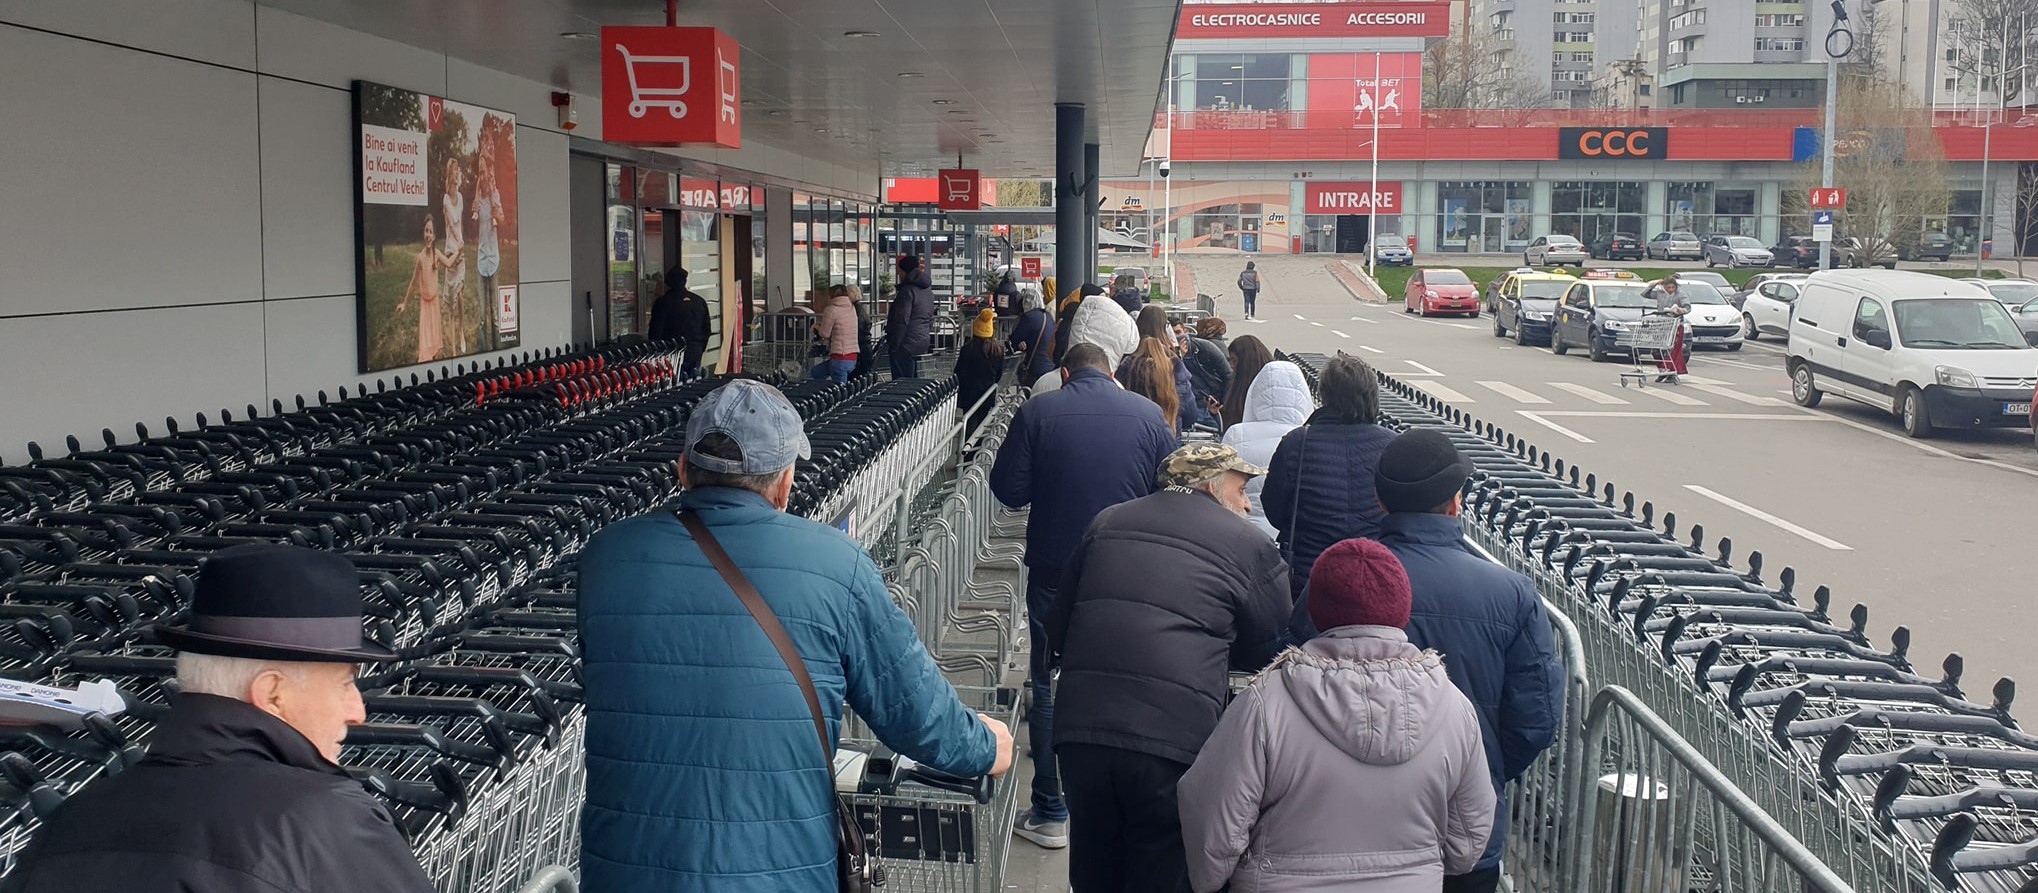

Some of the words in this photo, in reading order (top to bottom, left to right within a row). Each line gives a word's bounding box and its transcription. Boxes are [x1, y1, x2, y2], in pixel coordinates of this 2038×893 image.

[1192, 14, 1320, 26] ELECTROCASNICE
[1346, 13, 1425, 25] ACCESORII
[1381, 79, 1400, 87] BET
[365, 133, 385, 151] Bine
[387, 138, 395, 152] ai
[397, 140, 418, 155] venit
[1579, 130, 1649, 156] CCC
[365, 154, 374, 171] la
[376, 155, 415, 175] Kaufland
[366, 176, 399, 194] Centrul
[1124, 195, 1141, 205] dm
[1319, 192, 1393, 208] INTRARE
[1268, 212, 1284, 221] dm
[0, 682, 21, 691] NONE
[31, 687, 60, 697] DANONE
